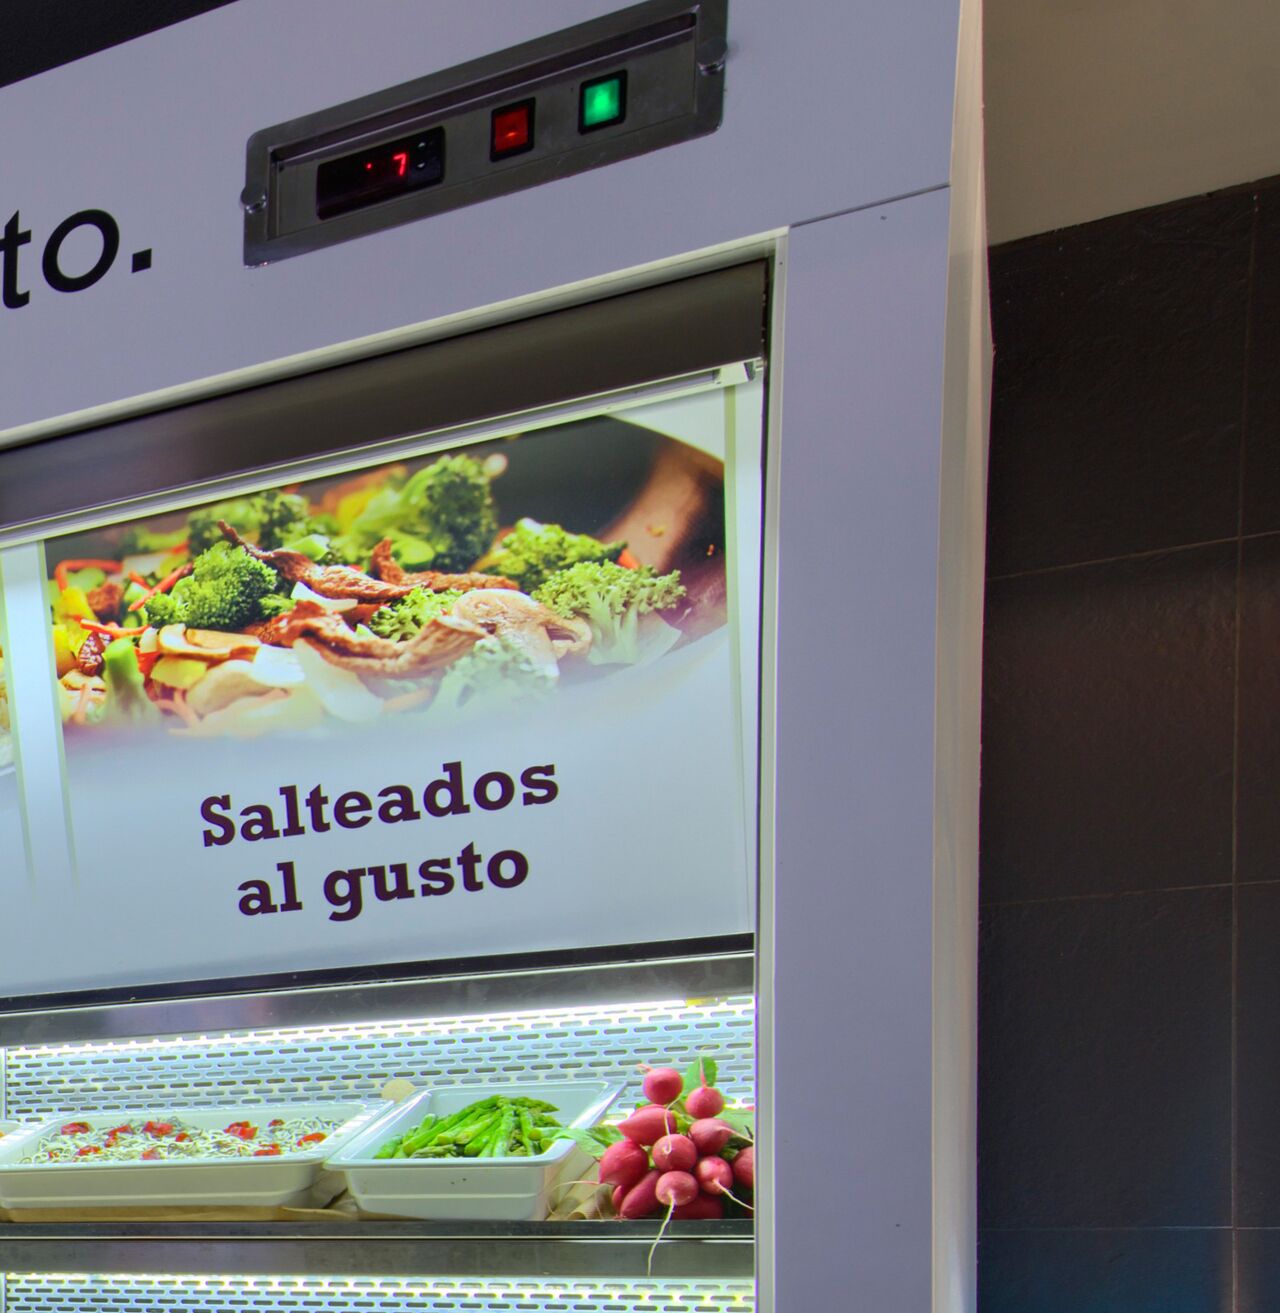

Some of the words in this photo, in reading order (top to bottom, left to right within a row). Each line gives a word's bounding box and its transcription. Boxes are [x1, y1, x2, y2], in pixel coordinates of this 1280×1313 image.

[201, 762, 558, 847] Salteados
[238, 862, 302, 915] al
[324, 842, 528, 921] gusto
